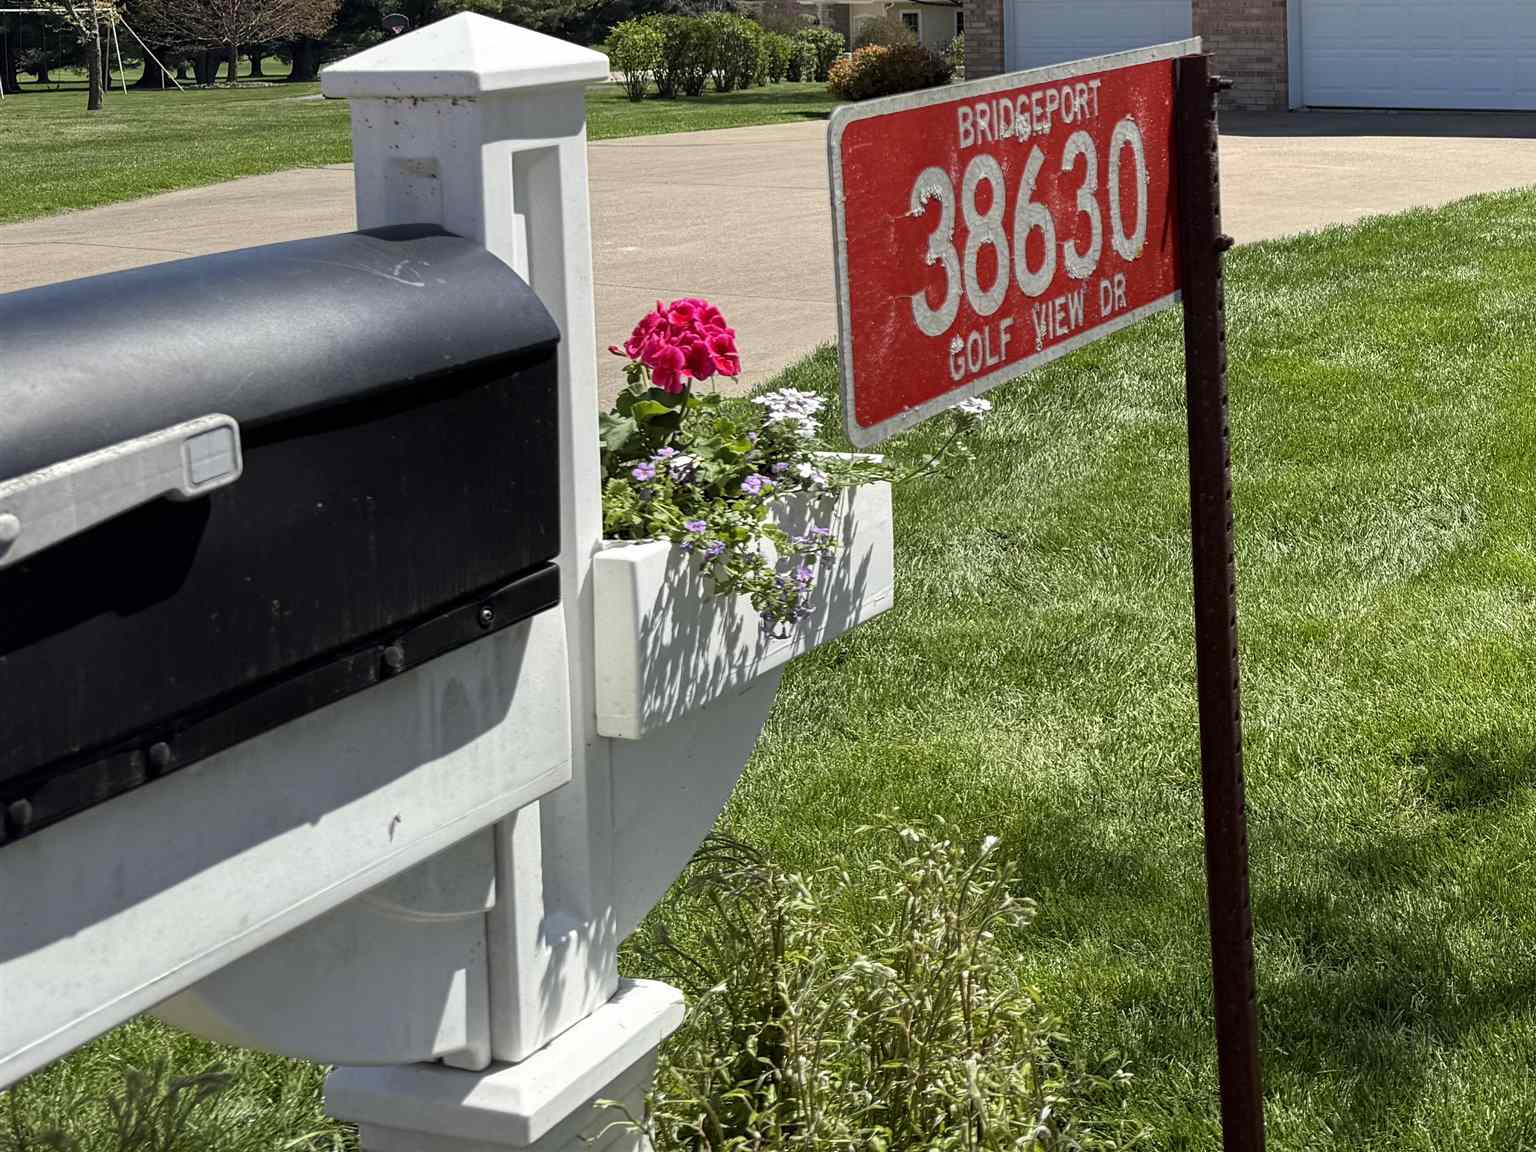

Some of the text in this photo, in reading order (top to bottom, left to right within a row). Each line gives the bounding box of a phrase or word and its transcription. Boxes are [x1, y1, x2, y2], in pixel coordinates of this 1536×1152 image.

[957, 78, 1101, 149] BRIDGEPORT
[909, 115, 1149, 337] 38630
[948, 272, 1129, 381] GOLF VIEW DR
